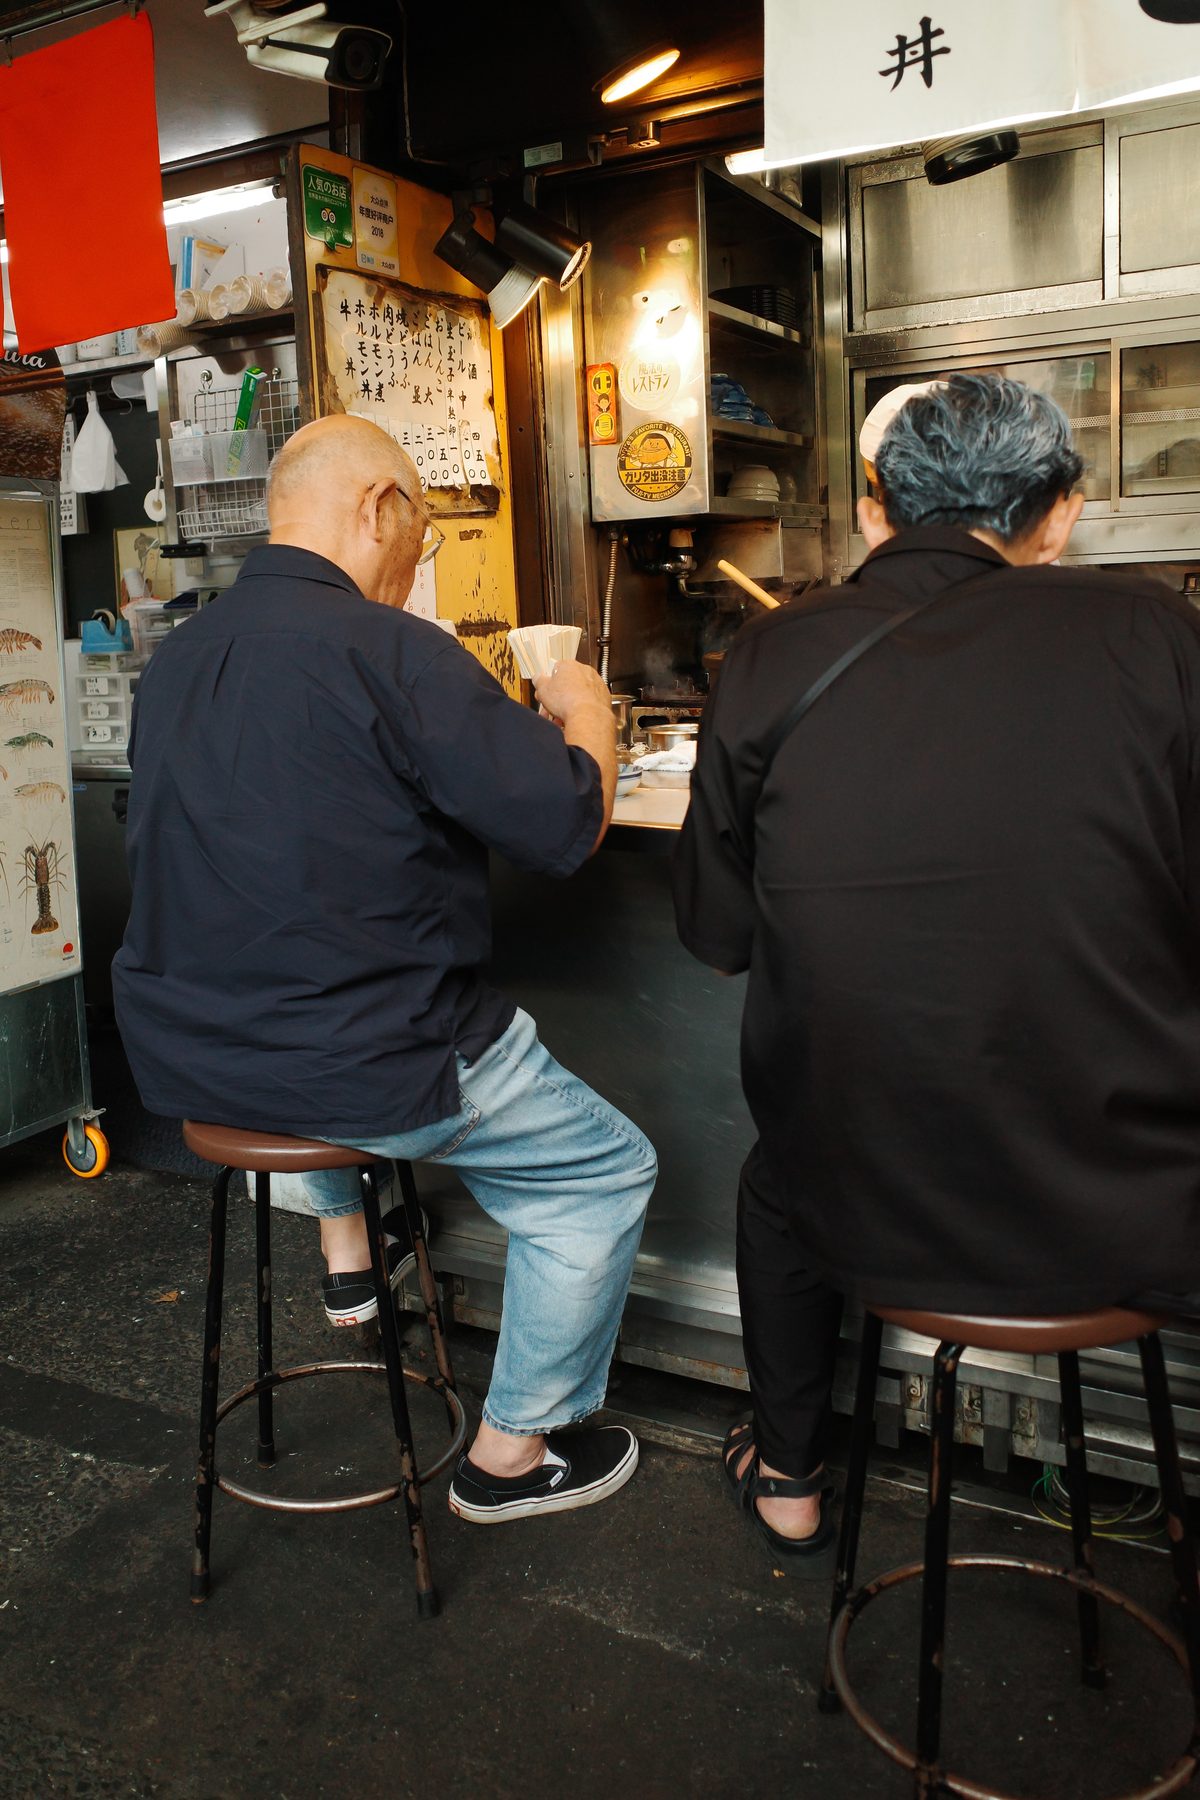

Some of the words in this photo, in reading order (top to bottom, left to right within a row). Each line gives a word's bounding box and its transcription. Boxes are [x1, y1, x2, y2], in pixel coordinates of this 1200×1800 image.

[878, 15, 952, 93] 丼
[307, 175, 347, 200] 人気のお店
[382, 303, 399, 388] 肉どうふ
[632, 373, 671, 393] レストラン
[634, 423, 663, 436] FAVORITE
[624, 468, 687, 483] ガリタ出没注意
